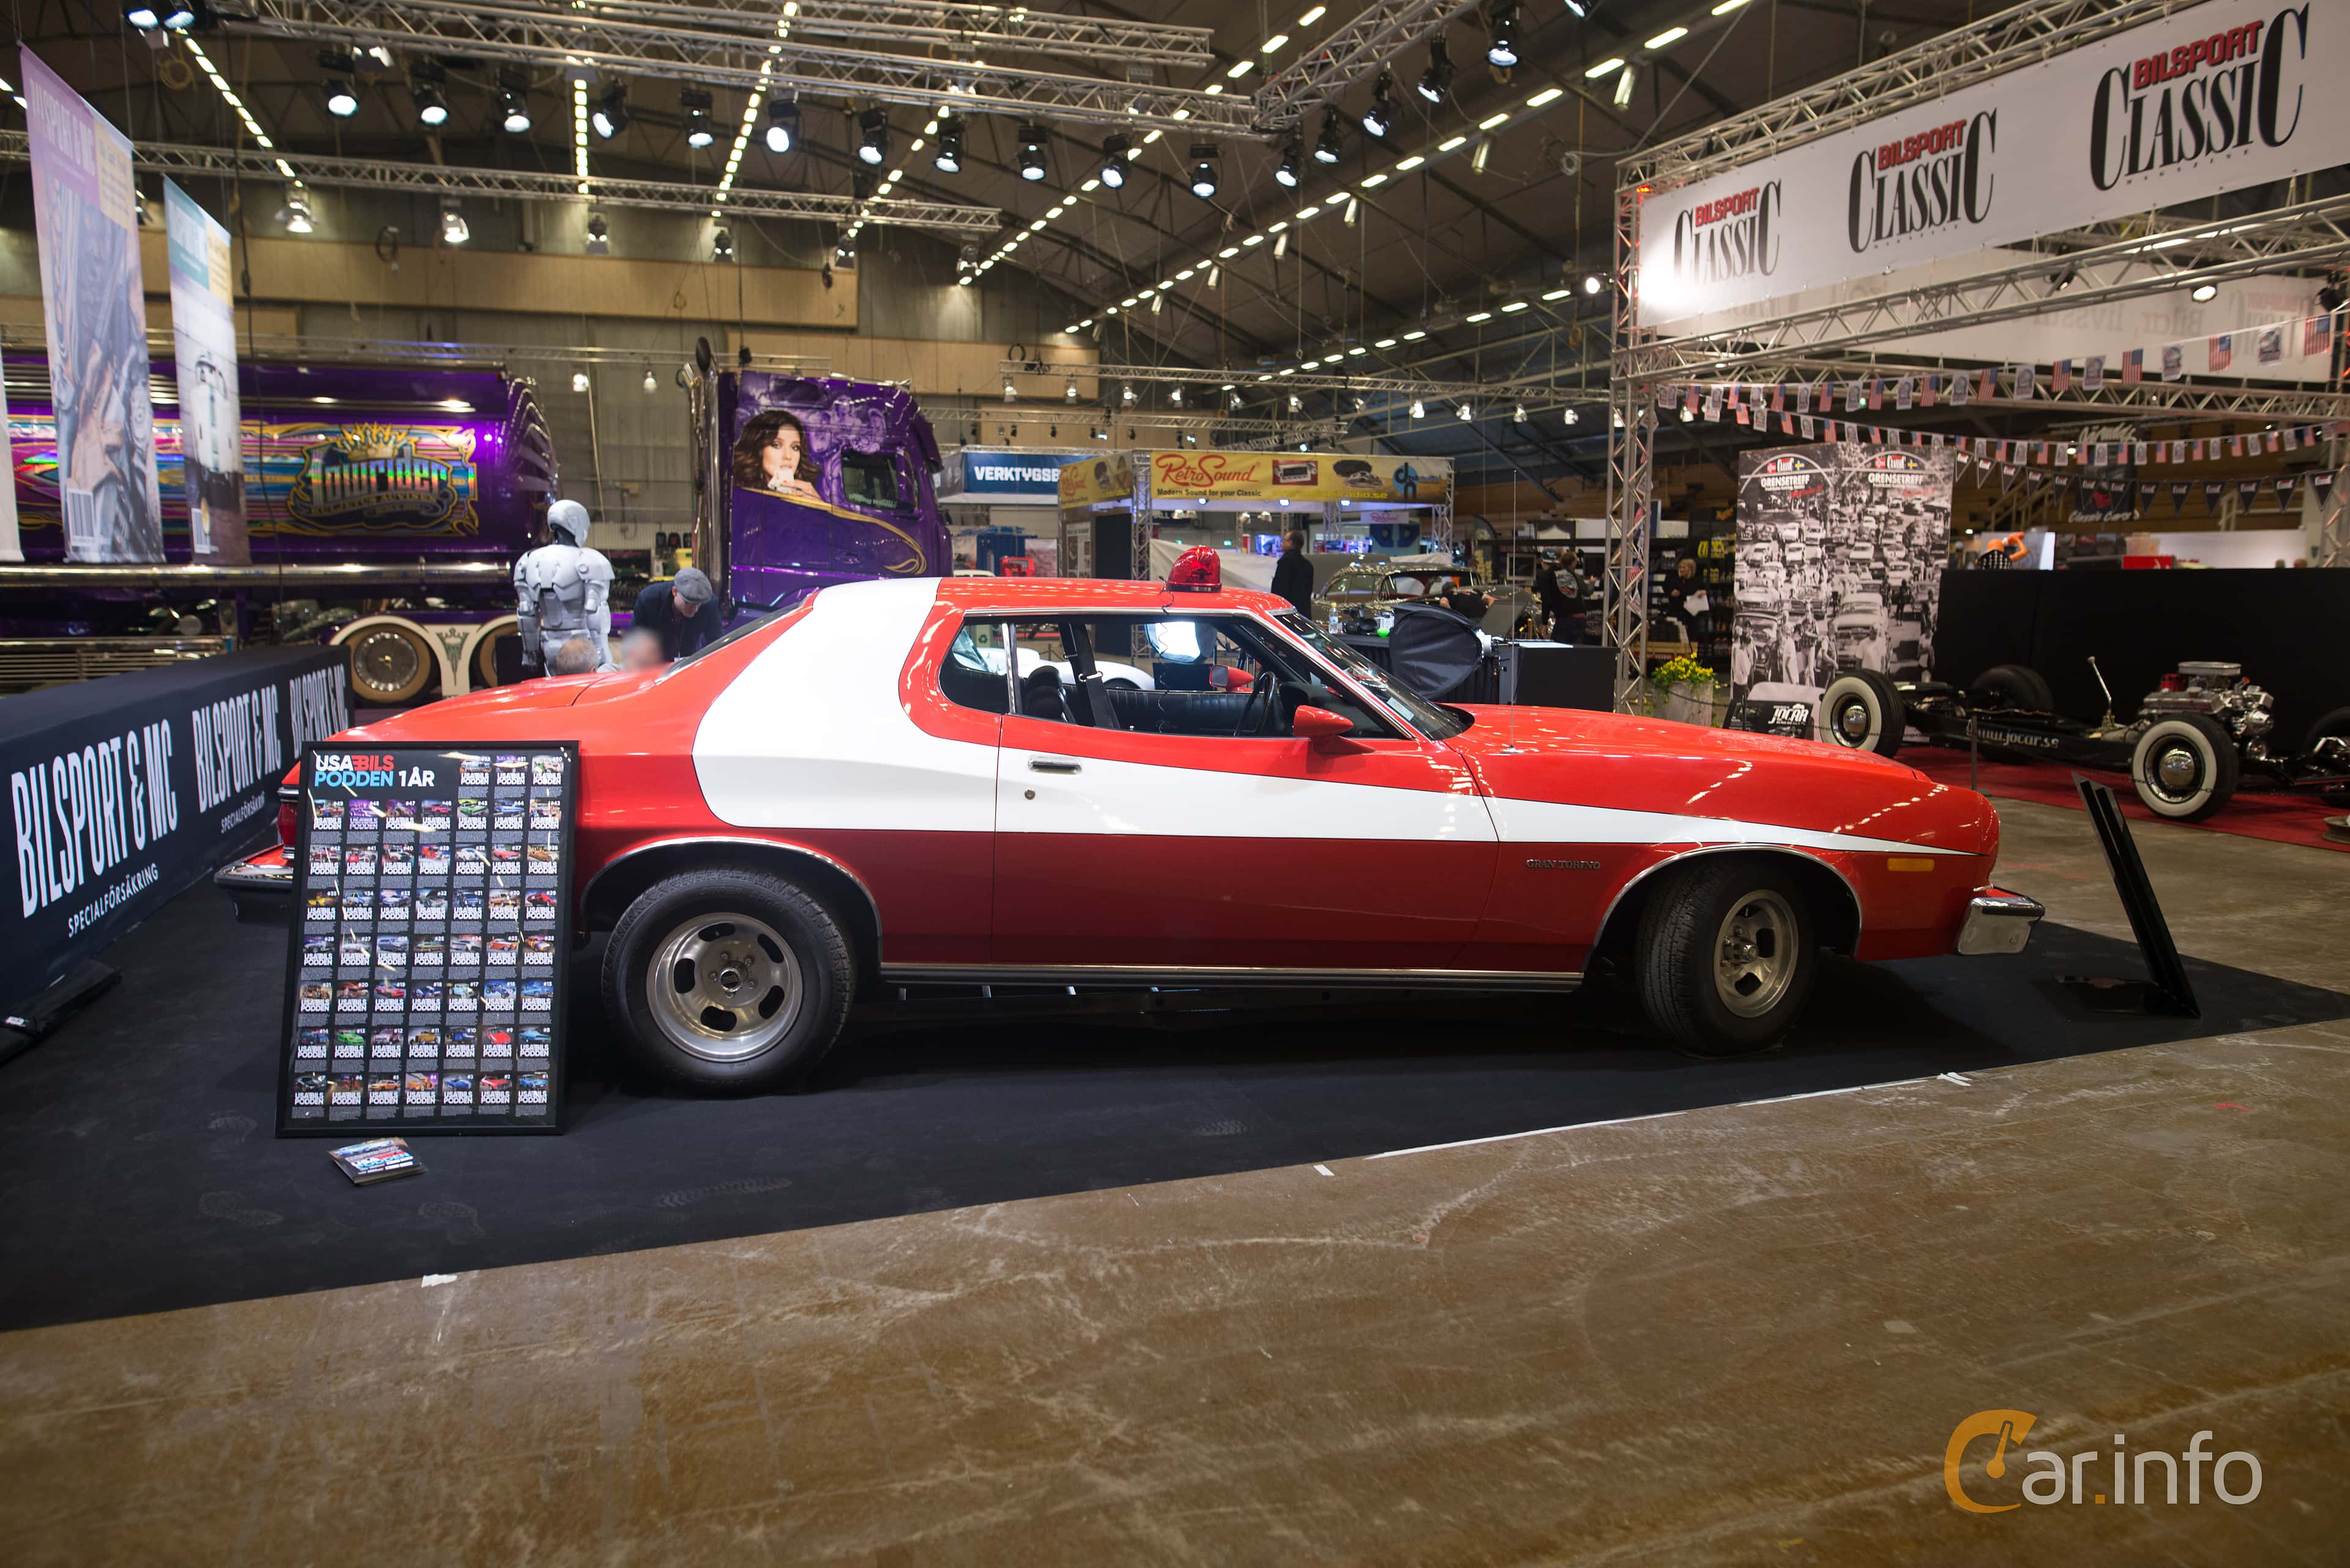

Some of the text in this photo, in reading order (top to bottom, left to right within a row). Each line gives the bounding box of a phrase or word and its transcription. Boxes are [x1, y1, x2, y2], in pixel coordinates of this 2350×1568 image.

[2133, 19, 2264, 91] BILSPORT
[2090, 1, 2310, 191] CLASSIC
[1878, 119, 1967, 171] BILSPORT
[1695, 187, 1760, 228] BILSPORT
[1848, 107, 1997, 253] CLASSIC
[1674, 178, 1781, 284] CLASSIC
[974, 466, 1061, 482] VERKTYGSB
[1761, 474, 1810, 487] GRENSETREFF
[1868, 473, 1923, 485] GRENSETREFF
[192, 684, 282, 813] BILSPORT & MC
[314, 771, 394, 787] PODDEN
[11, 718, 177, 919] BILSPORT & MC
[1526, 859, 1600, 870] GRAN TORINO
[69, 862, 159, 938] SPECIALFÖRSÄKRING
